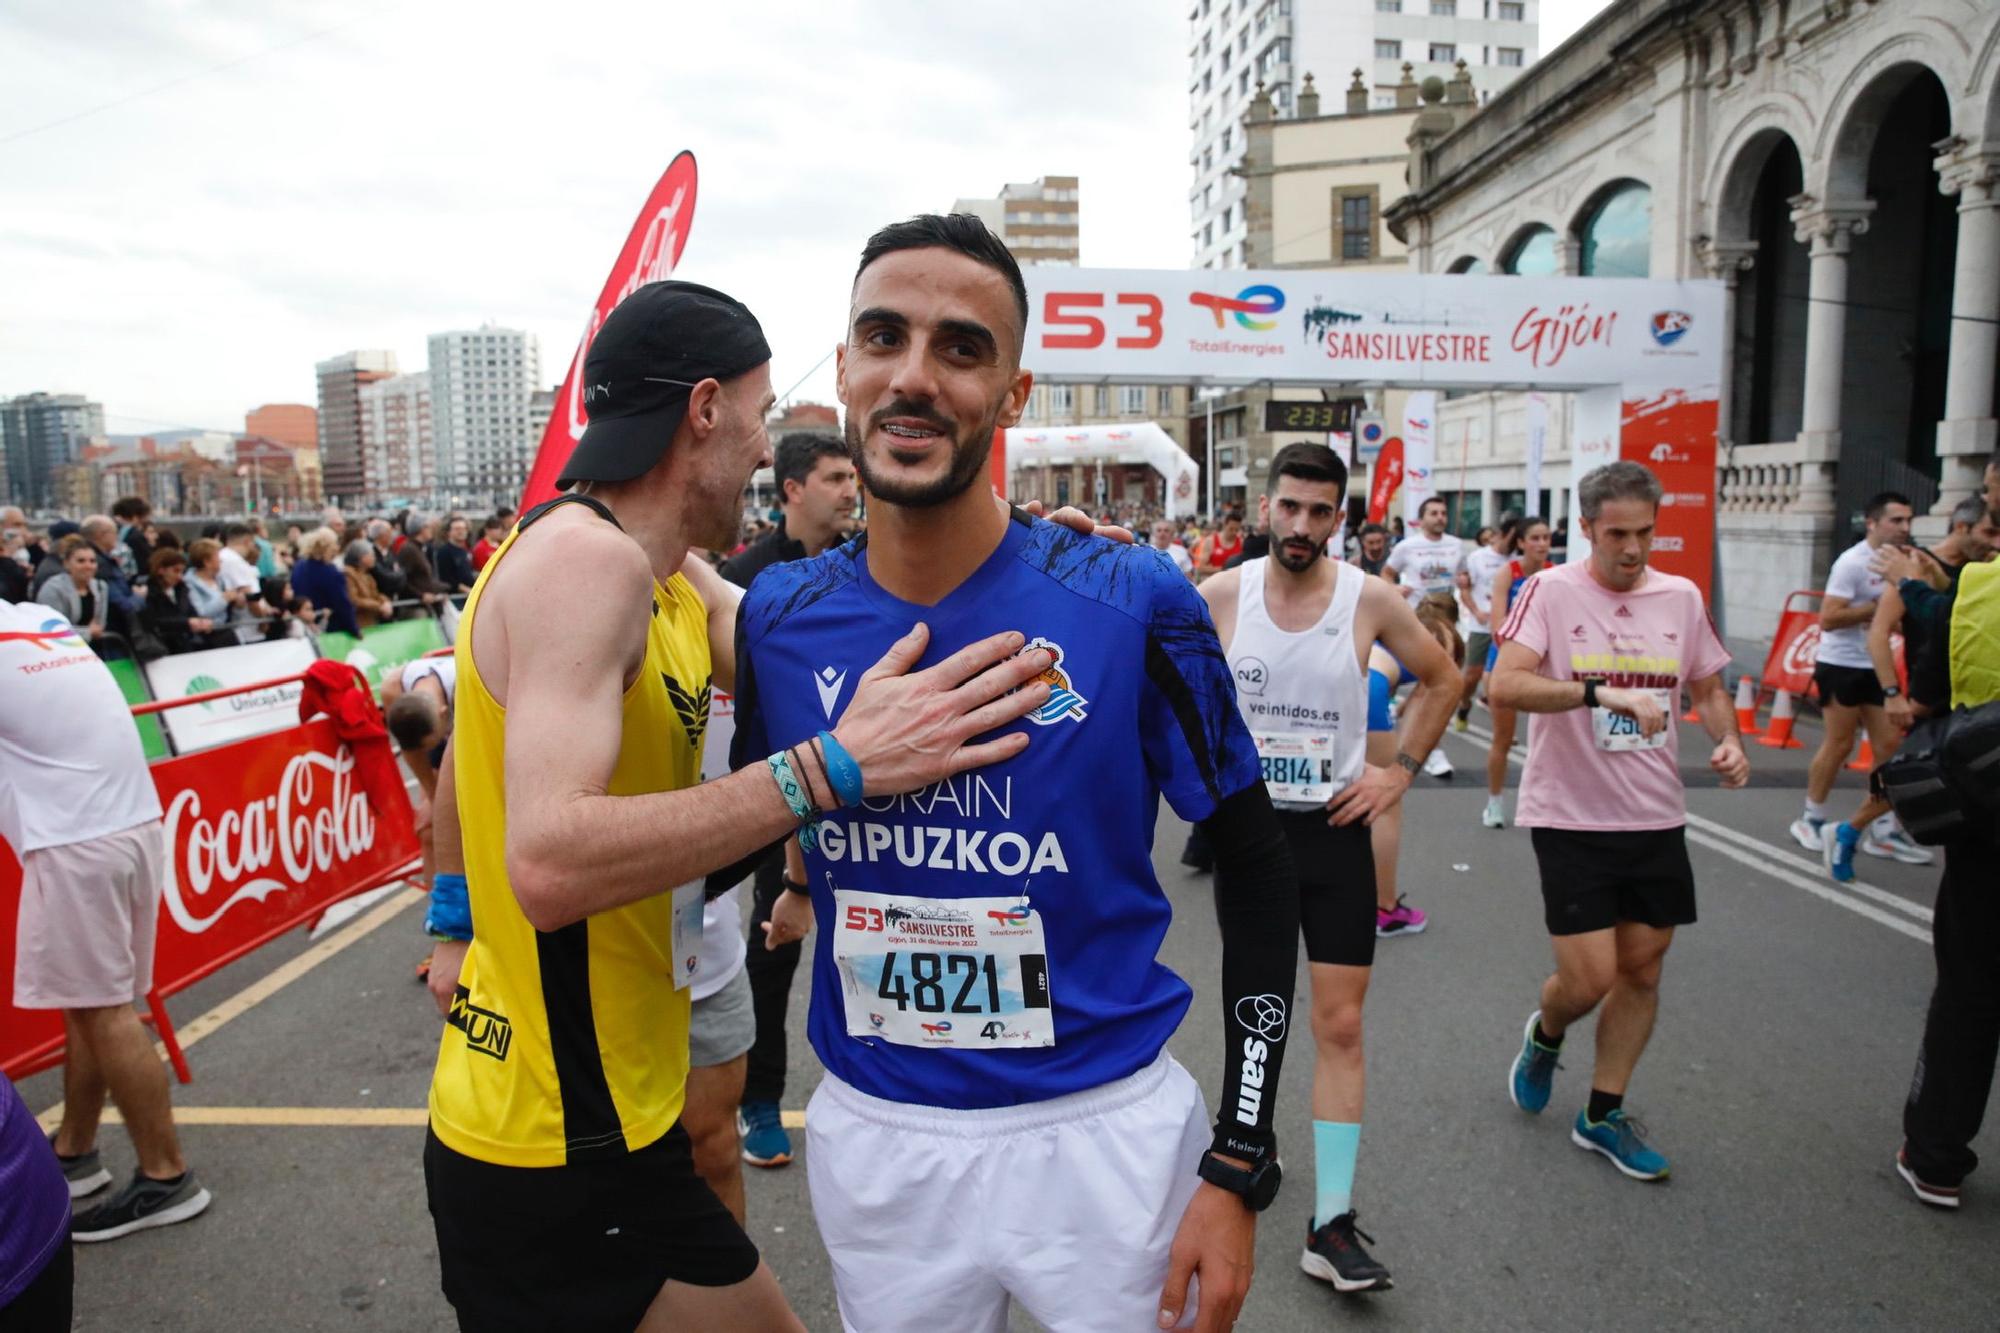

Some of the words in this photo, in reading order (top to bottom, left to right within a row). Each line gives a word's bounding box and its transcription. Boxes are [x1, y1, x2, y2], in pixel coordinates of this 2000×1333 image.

[1042, 292, 1164, 349] 53
[1511, 303, 1617, 368] Gijón
[1189, 339, 1284, 357] TotalEnergies
[1327, 332, 1491, 362] SANSILVESTRE
[1248, 702, 1340, 722] veintidos.es
[163, 744, 375, 934] Coca-Cola
[819, 820, 1069, 876] GIPUZKOA
[845, 905, 884, 932] 53
[899, 921, 976, 938] SANSILVESTRE
[989, 928, 1033, 937] TotalEnergies
[878, 952, 1000, 1013] 4821
[1038, 971, 1047, 991] 4821
[1236, 1036, 1268, 1126] sam
